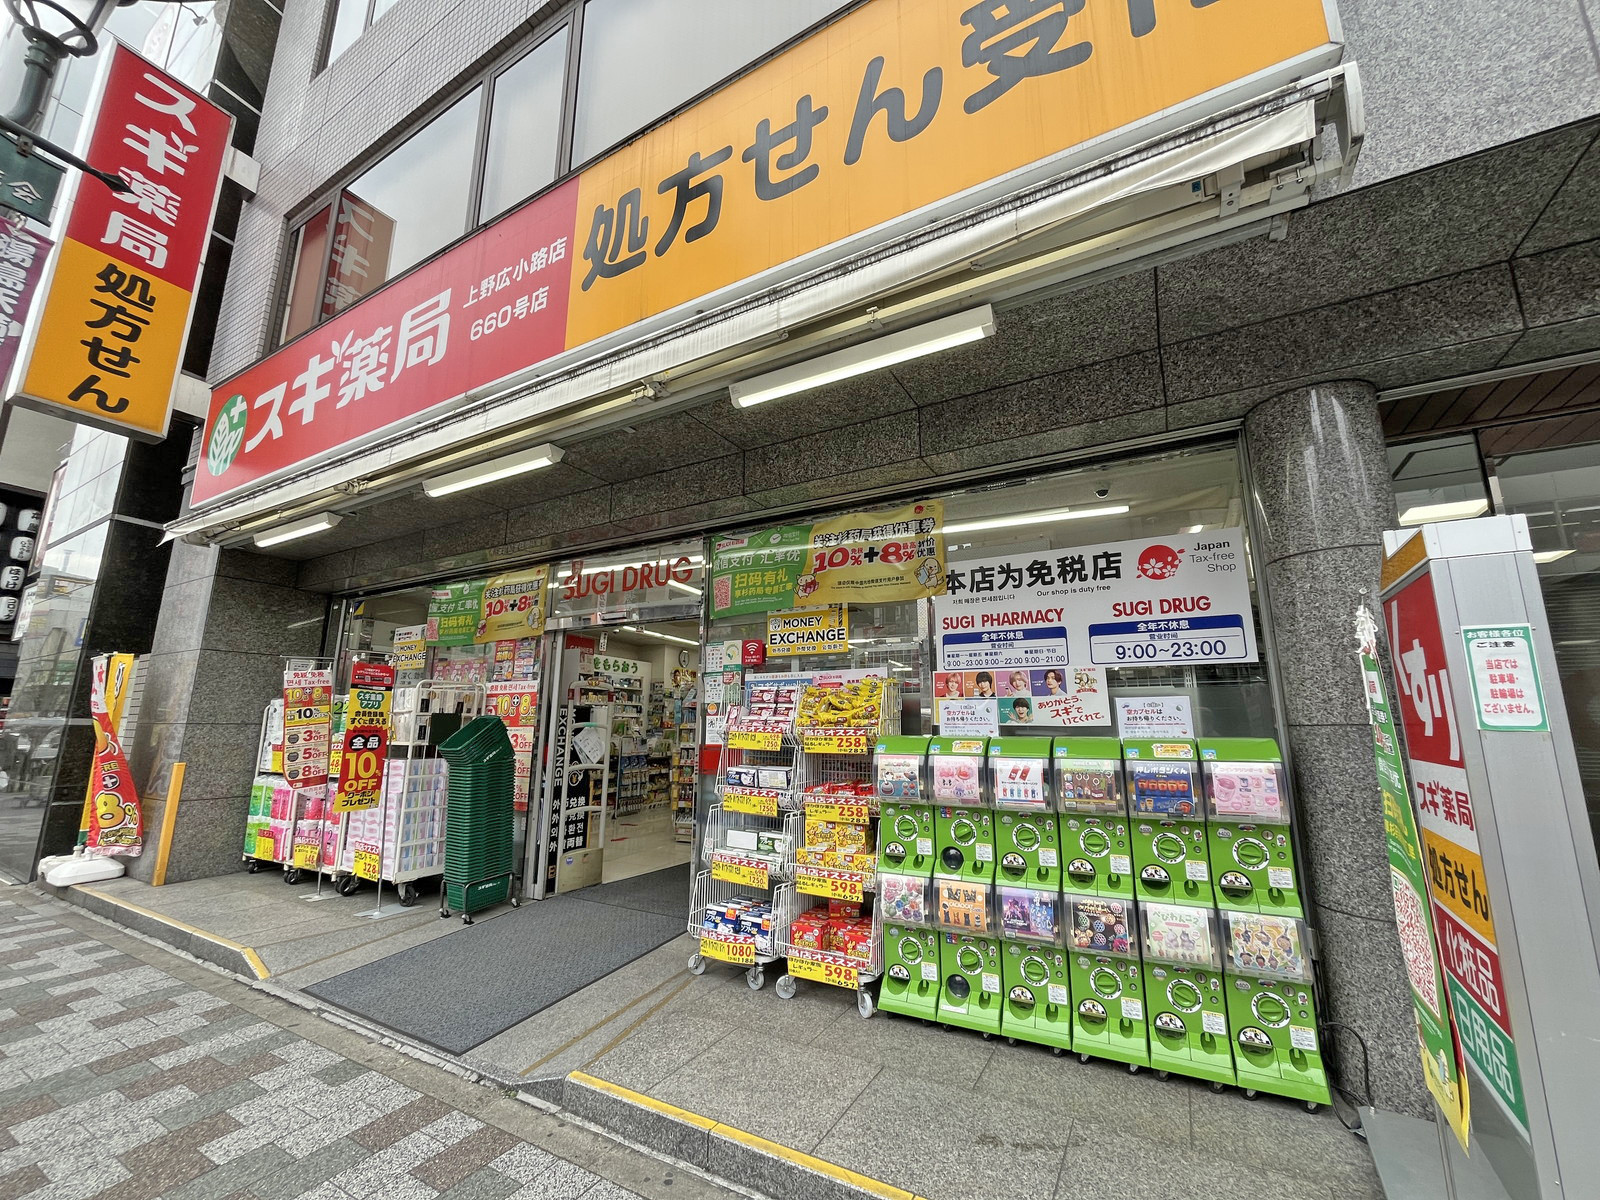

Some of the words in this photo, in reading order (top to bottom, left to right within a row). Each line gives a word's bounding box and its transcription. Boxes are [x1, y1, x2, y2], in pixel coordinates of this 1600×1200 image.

[581, 0, 1220, 292] 処方せん受
[101, 72, 199, 270] スギ薬局
[463, 236, 567, 308] 上野広小路店
[470, 286, 549, 341] 660号店
[67, 263, 156, 414] 処方せん
[245, 288, 452, 453] スギ薬局
[1194, 540, 1231, 552] Japan
[1189, 552, 1236, 564] Tax-free
[946, 551, 1123, 595] 本店为免税店
[1207, 563, 1237, 574] Shop
[563, 568, 615, 600] SUGI
[622, 556, 693, 592] DRUG
[735, 568, 789, 588] 扫码有礼
[1036, 589, 1050, 597] Our
[1051, 588, 1069, 597] shop
[1078, 585, 1095, 594] duty
[1096, 584, 1111, 592] free
[1112, 600, 1153, 618] SUGI
[1159, 596, 1211, 615] DRUG
[783, 616, 823, 629] MONEY
[942, 615, 975, 630] SUGI
[981, 608, 1065, 627] PHARMACY
[1137, 620, 1190, 631] 全年不休息
[769, 628, 846, 645] EXCHANGE
[981, 631, 1024, 642] 全年不休息
[1466, 629, 1525, 639] お客様各位
[1476, 640, 1516, 648] ご注意
[392, 651, 427, 663] EXCHANGE
[1485, 659, 1519, 670] 当店では
[1489, 688, 1525, 699] 駐輪場は
[361, 700, 379, 708] アプリ
[1484, 702, 1535, 714] ございません。
[1050, 704, 1084, 719] スギで
[351, 736, 380, 749] 全品
[519, 742, 532, 750] OFF
[553, 707, 568, 787] EXCHANGE
[312, 751, 326, 759] OFF
[517, 767, 530, 775] OFF
[343, 778, 378, 791] OFF
[347, 789, 374, 799] クーポン
[341, 798, 376, 807] プレゼント
[1417, 780, 1475, 832] スギ薬局
[549, 835, 584, 852] 外両替
[796, 866, 863, 882] 当店オススメ
[1426, 842, 1489, 922] 処方せん
[788, 948, 858, 967] 当店オススメ
[1445, 921, 1502, 1018] 化粧品
[1455, 989, 1516, 1105] 日用品
